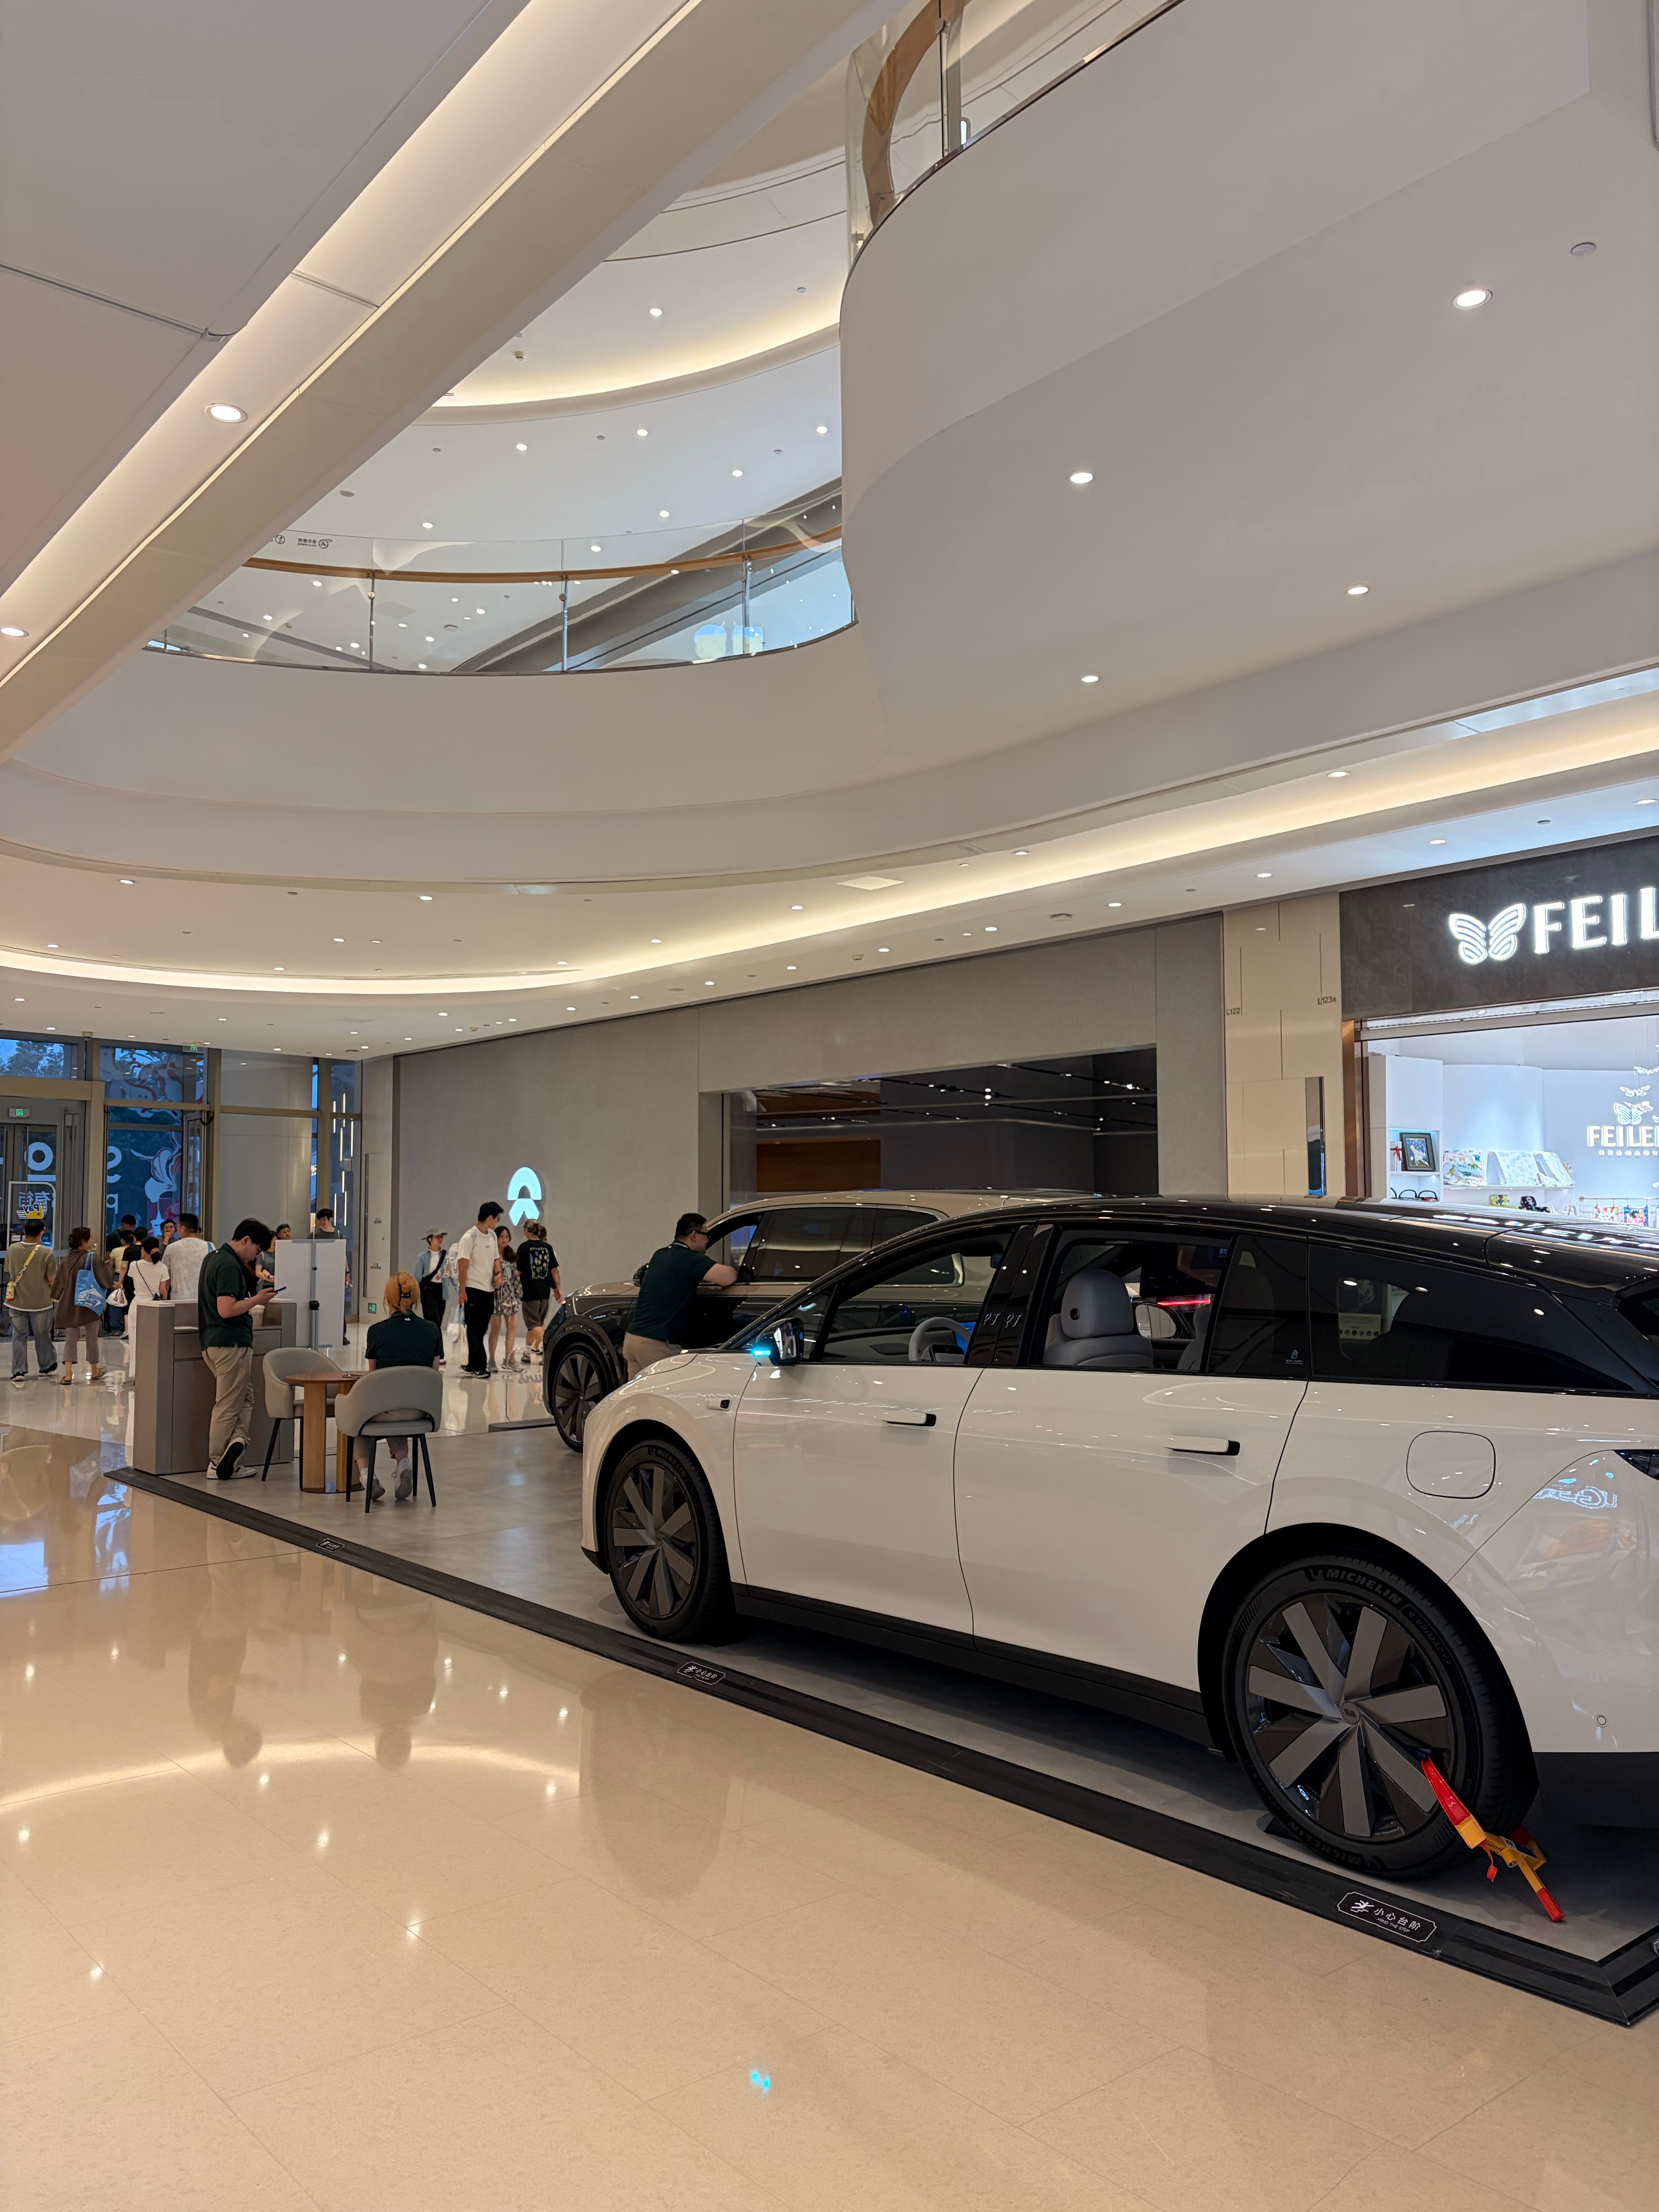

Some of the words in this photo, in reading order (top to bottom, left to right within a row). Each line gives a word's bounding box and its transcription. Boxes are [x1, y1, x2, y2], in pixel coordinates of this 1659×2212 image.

[1534, 887, 1659, 954] FEIL
[1317, 996, 1336, 1005] L123a
[1327, 1569, 1403, 1604] MICHELIN
[1374, 1908, 1420, 1931] 小心台阶
